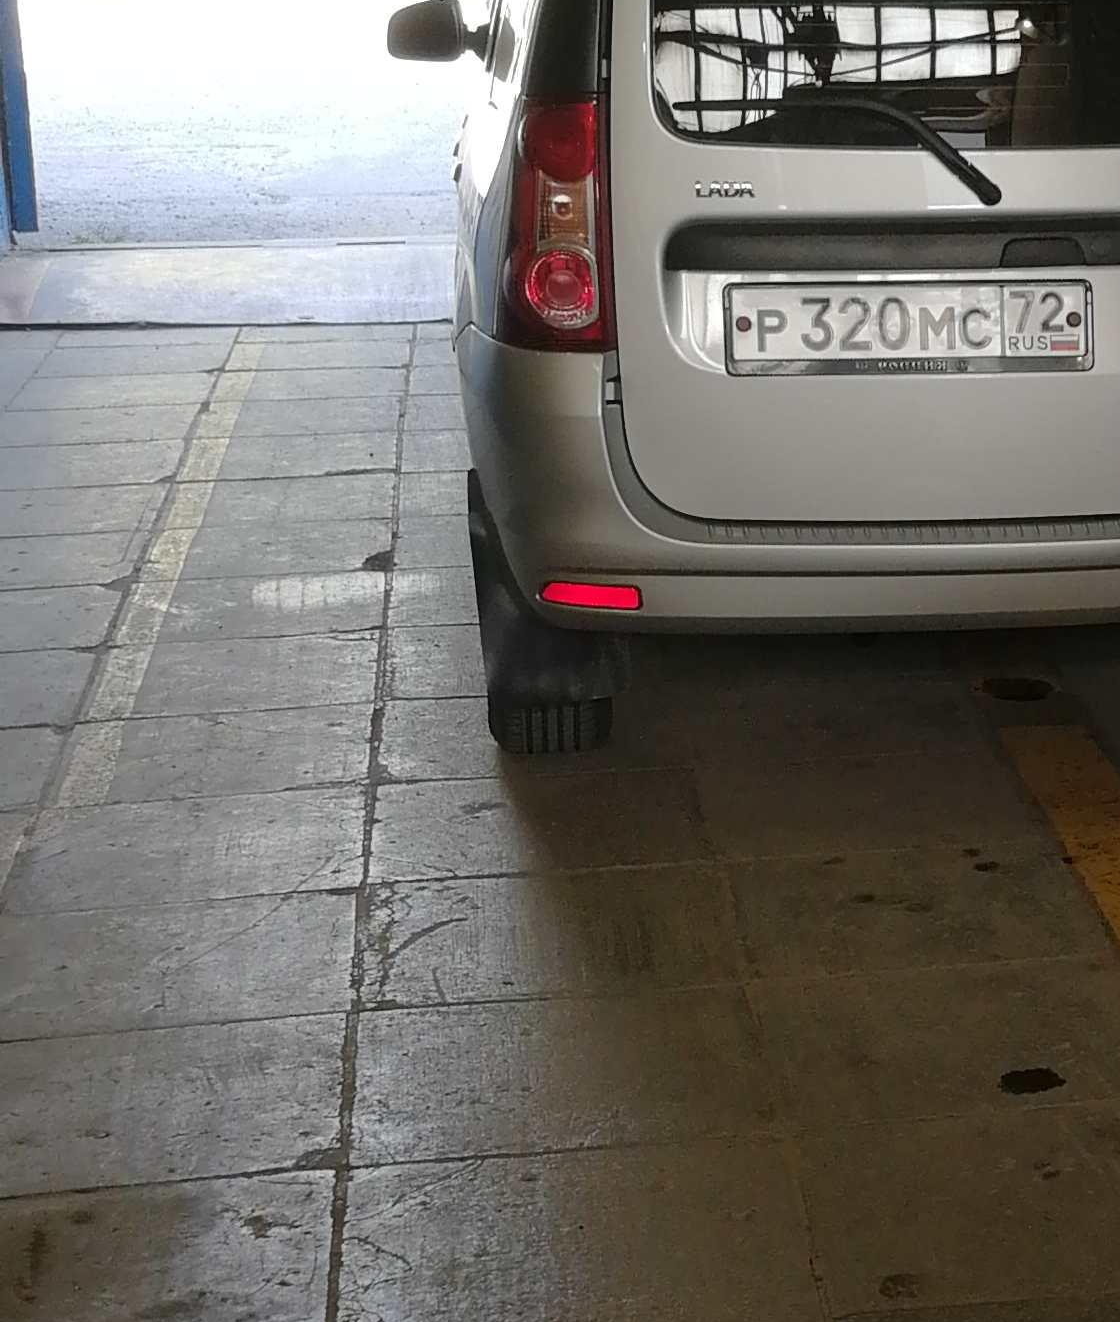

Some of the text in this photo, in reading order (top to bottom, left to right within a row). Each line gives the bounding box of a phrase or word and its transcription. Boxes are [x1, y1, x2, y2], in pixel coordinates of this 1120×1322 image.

[695, 181, 755, 198] LADA
[1008, 290, 1065, 333] 72
[1008, 336, 1049, 351] RUS
